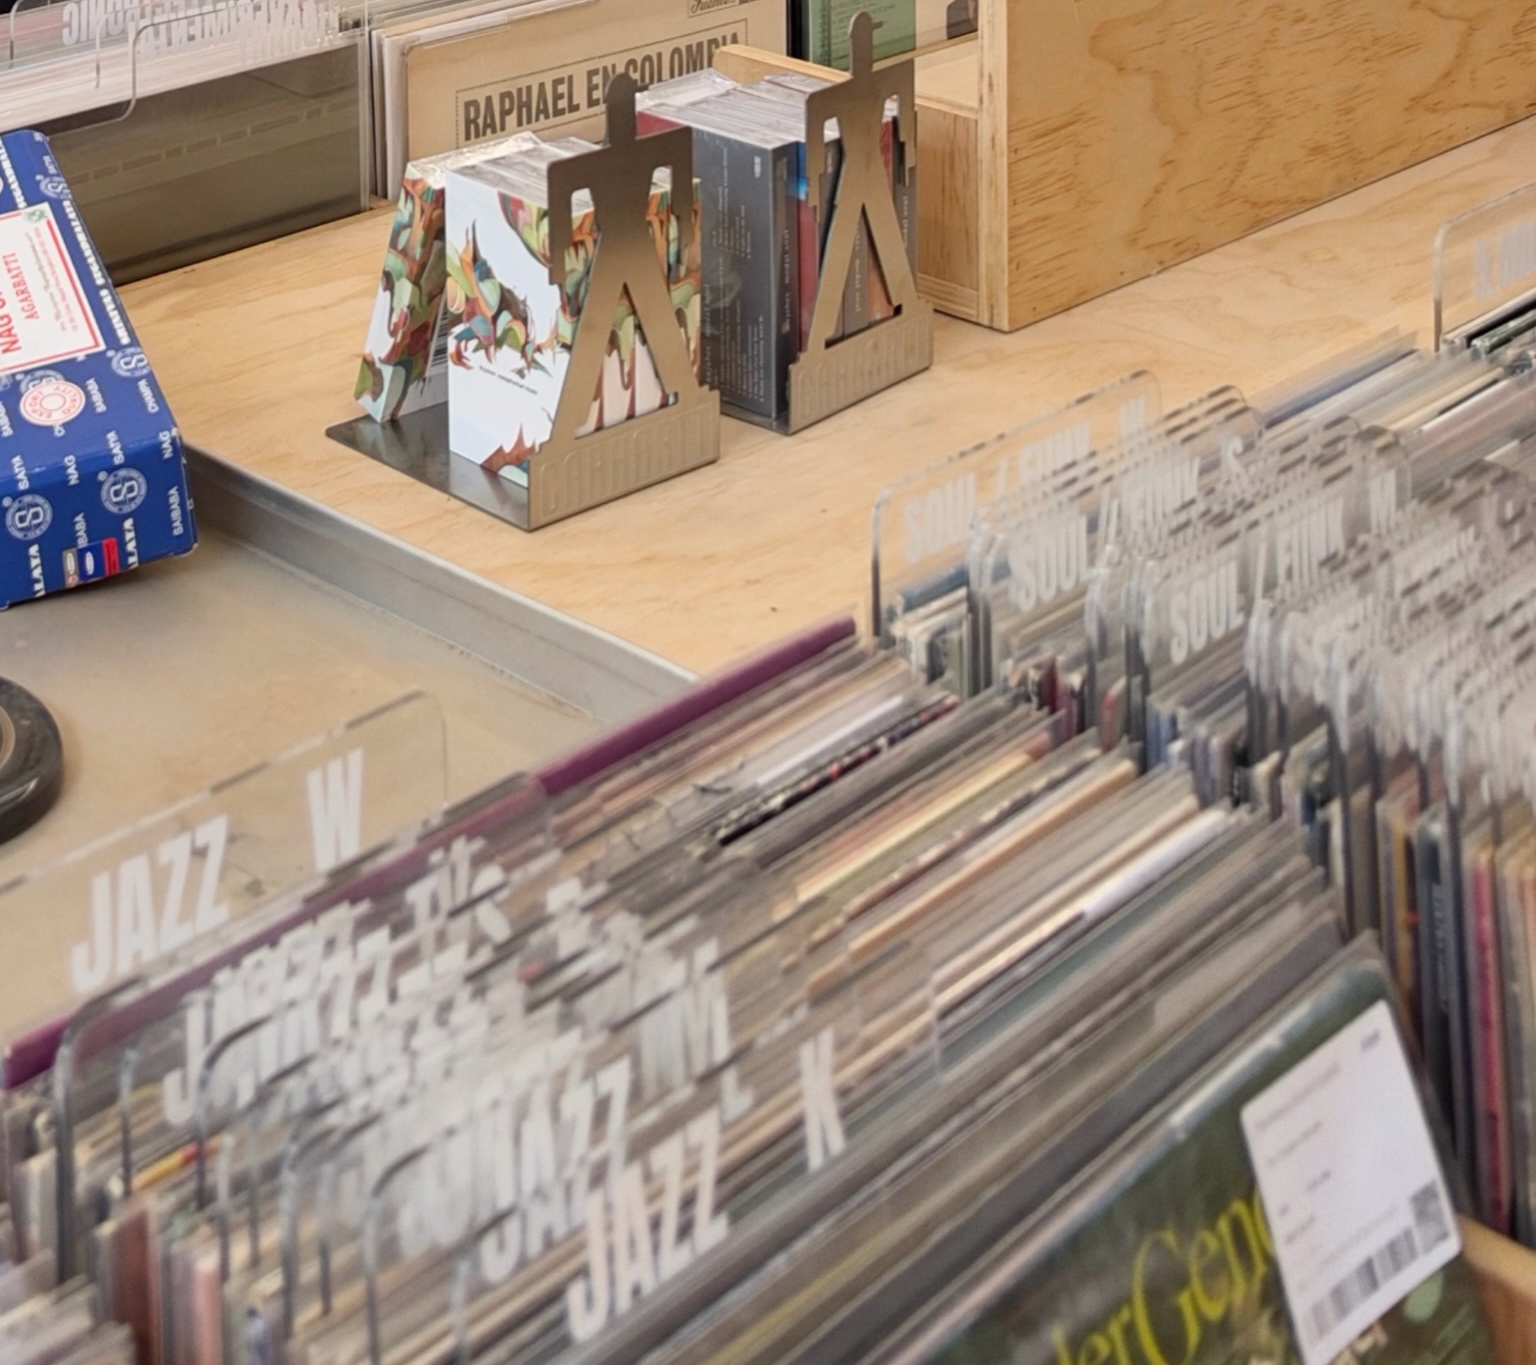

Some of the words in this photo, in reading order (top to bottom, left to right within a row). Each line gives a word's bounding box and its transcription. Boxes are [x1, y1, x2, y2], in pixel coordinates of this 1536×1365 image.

[463, 73, 581, 142] RAPHAEL
[2, 252, 40, 320] AGARBATTI
[64, 454, 80, 485] NAG
[159, 430, 174, 459] NAG
[165, 485, 184, 536] SAIBABA
[1170, 565, 1245, 664] SOUL
[71, 814, 231, 993] JAZZ
[306, 749, 364, 872] W
[567, 1109, 729, 1343] JAZZ
[799, 1027, 846, 1172] K
